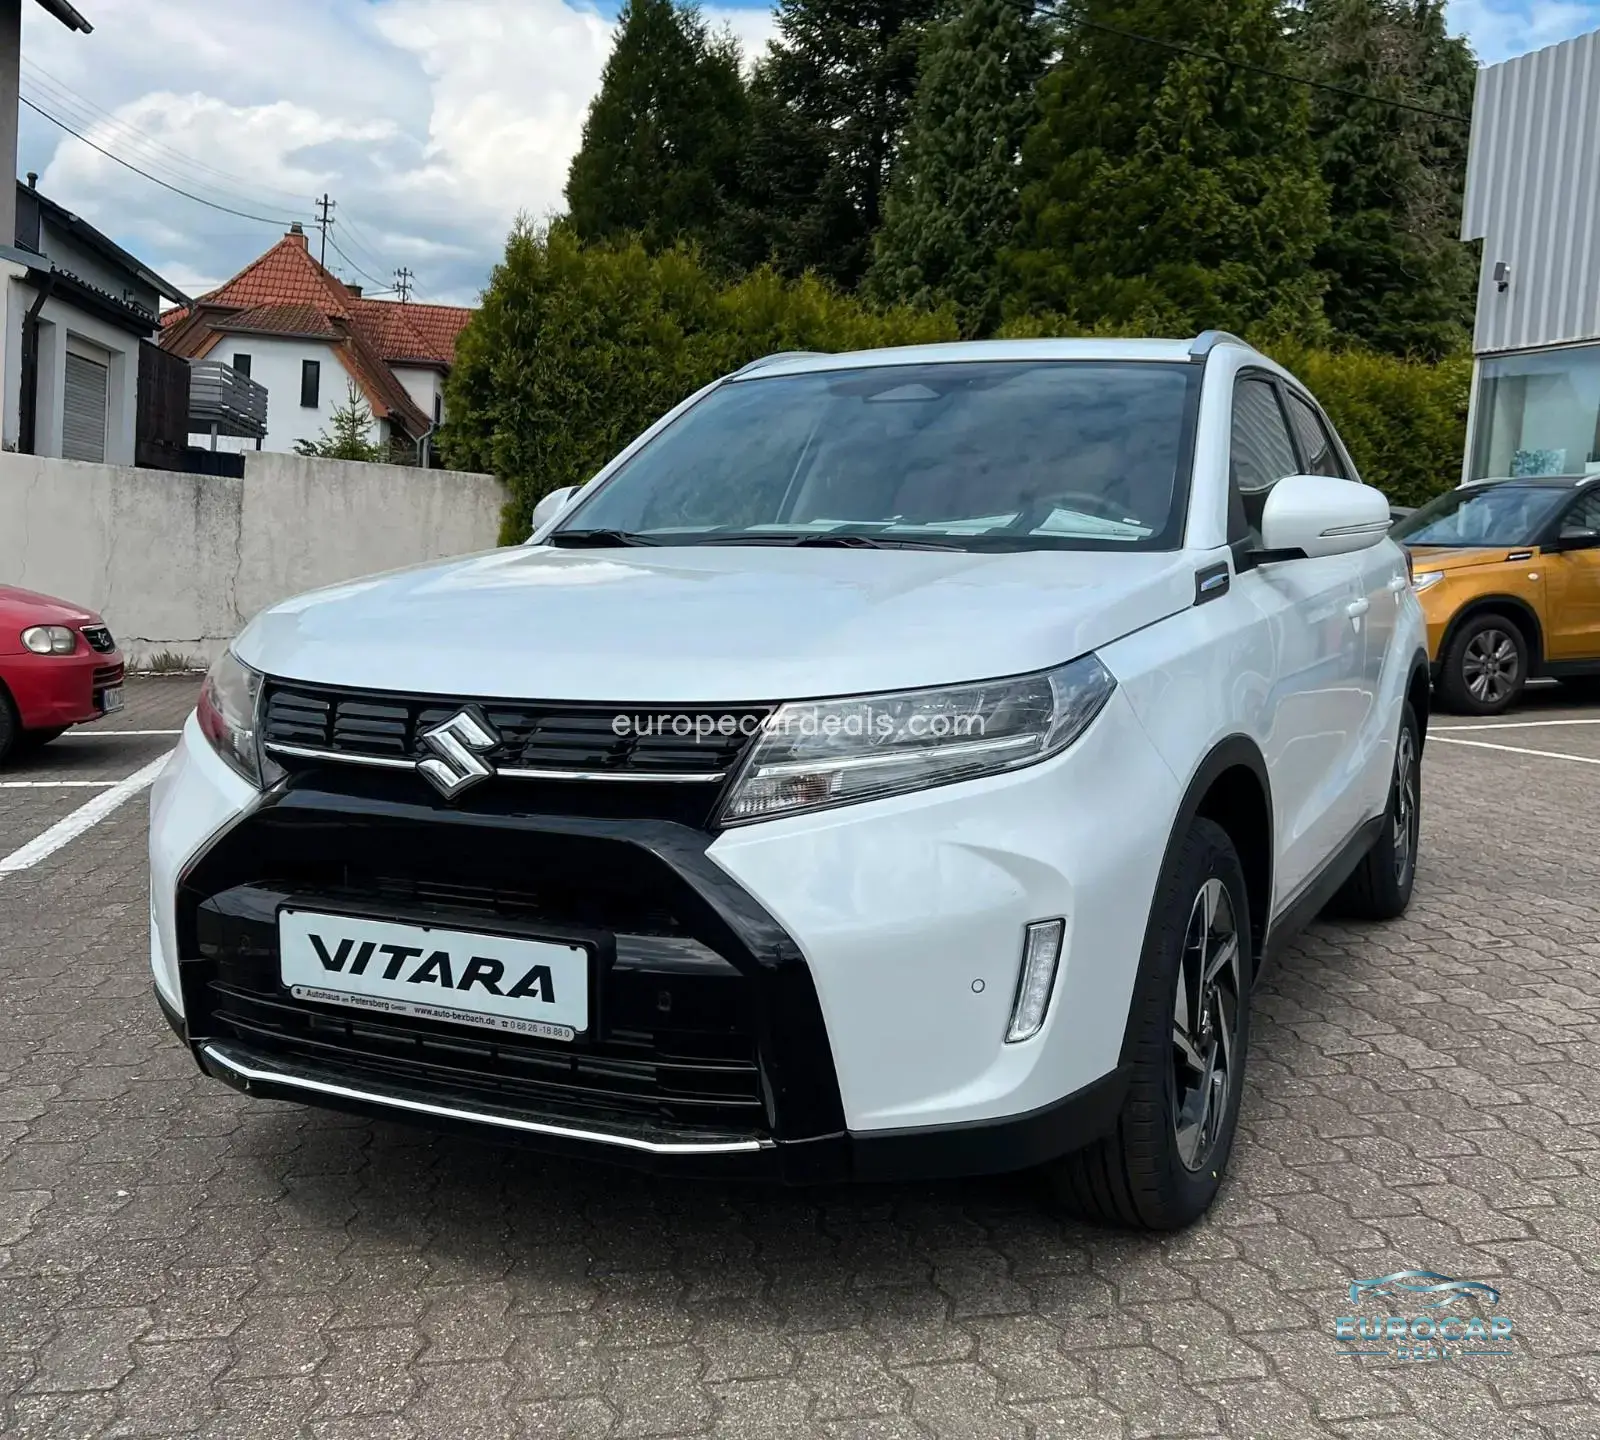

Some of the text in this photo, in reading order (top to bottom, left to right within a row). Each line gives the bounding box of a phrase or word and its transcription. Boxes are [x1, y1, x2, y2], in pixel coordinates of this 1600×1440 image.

[308, 933, 556, 1004] VITARA
[306, 989, 340, 1002] Autohaus
[350, 995, 390, 1010] Petersberg
[414, 1006, 496, 1026] www.auto-bexbach.de
